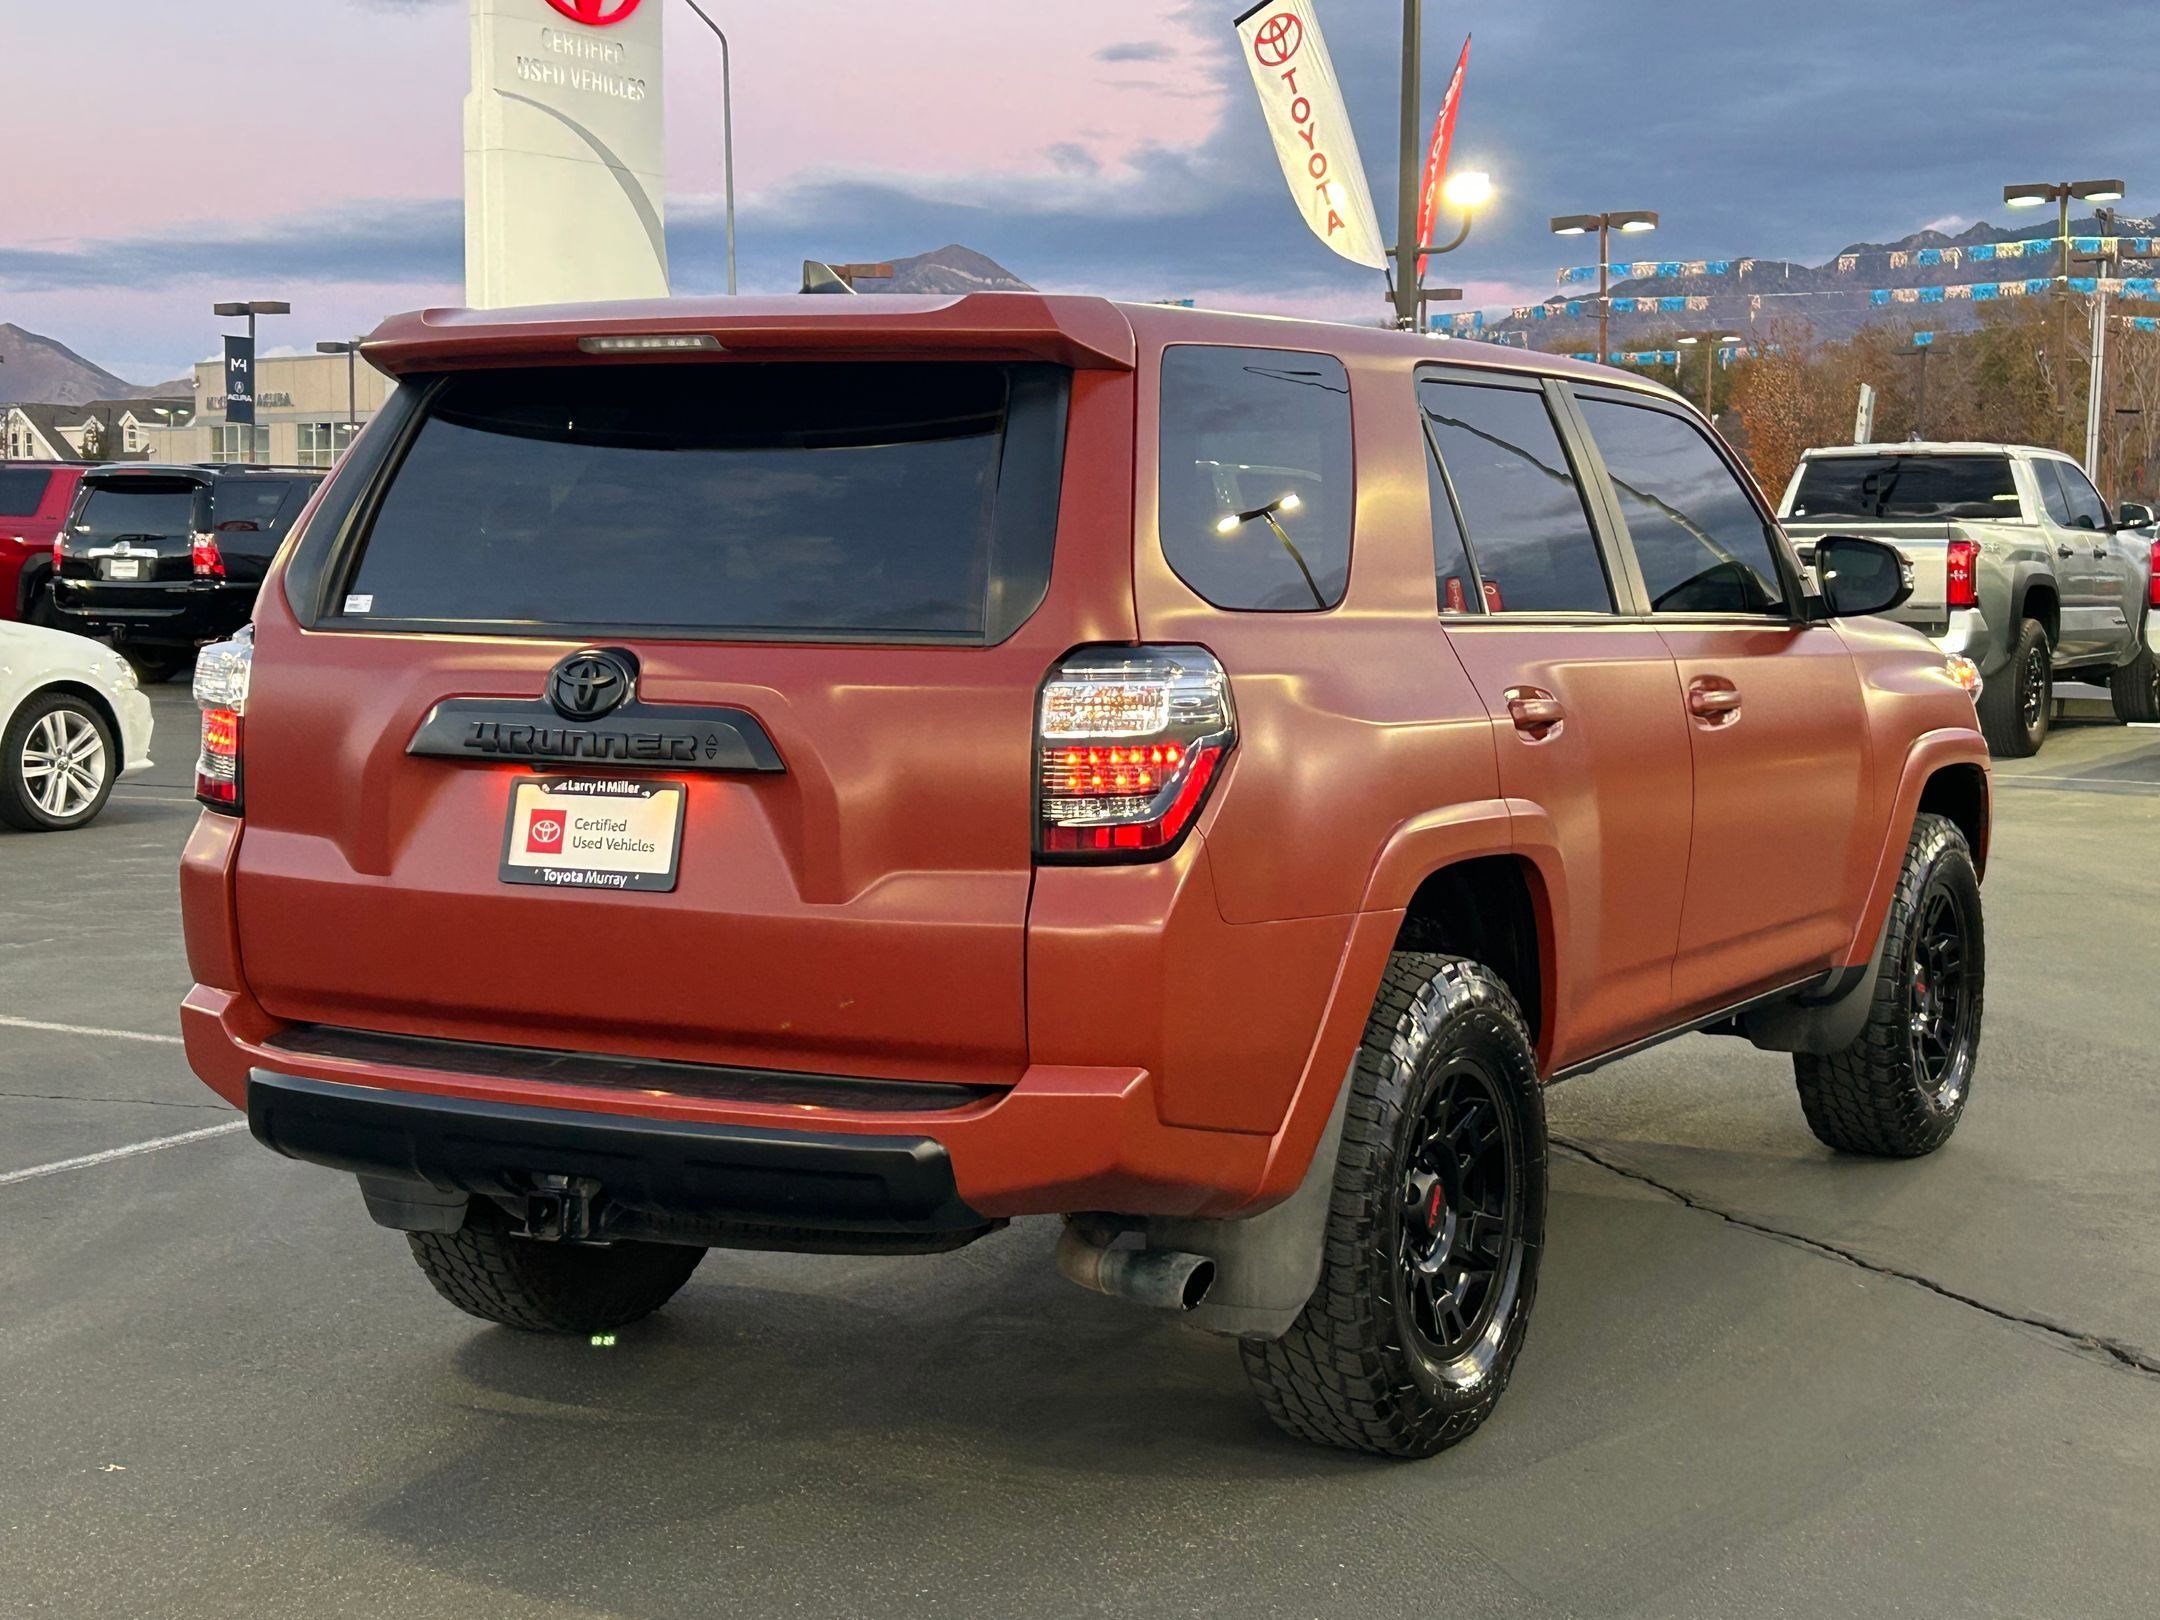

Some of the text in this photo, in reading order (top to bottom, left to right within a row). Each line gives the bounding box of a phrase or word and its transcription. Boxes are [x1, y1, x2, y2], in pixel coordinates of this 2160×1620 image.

[517, 55, 645, 100] USED VEHICLES
[1281, 67, 1345, 236] TOYOTA
[227, 393, 252, 402] ACURA
[464, 721, 697, 761] 4RUNNER
[568, 779, 640, 795] Larry H Miller
[574, 817, 628, 833] Certified
[572, 835, 656, 853] Used Vehicles
[542, 868, 628, 888] Toyota Murray
